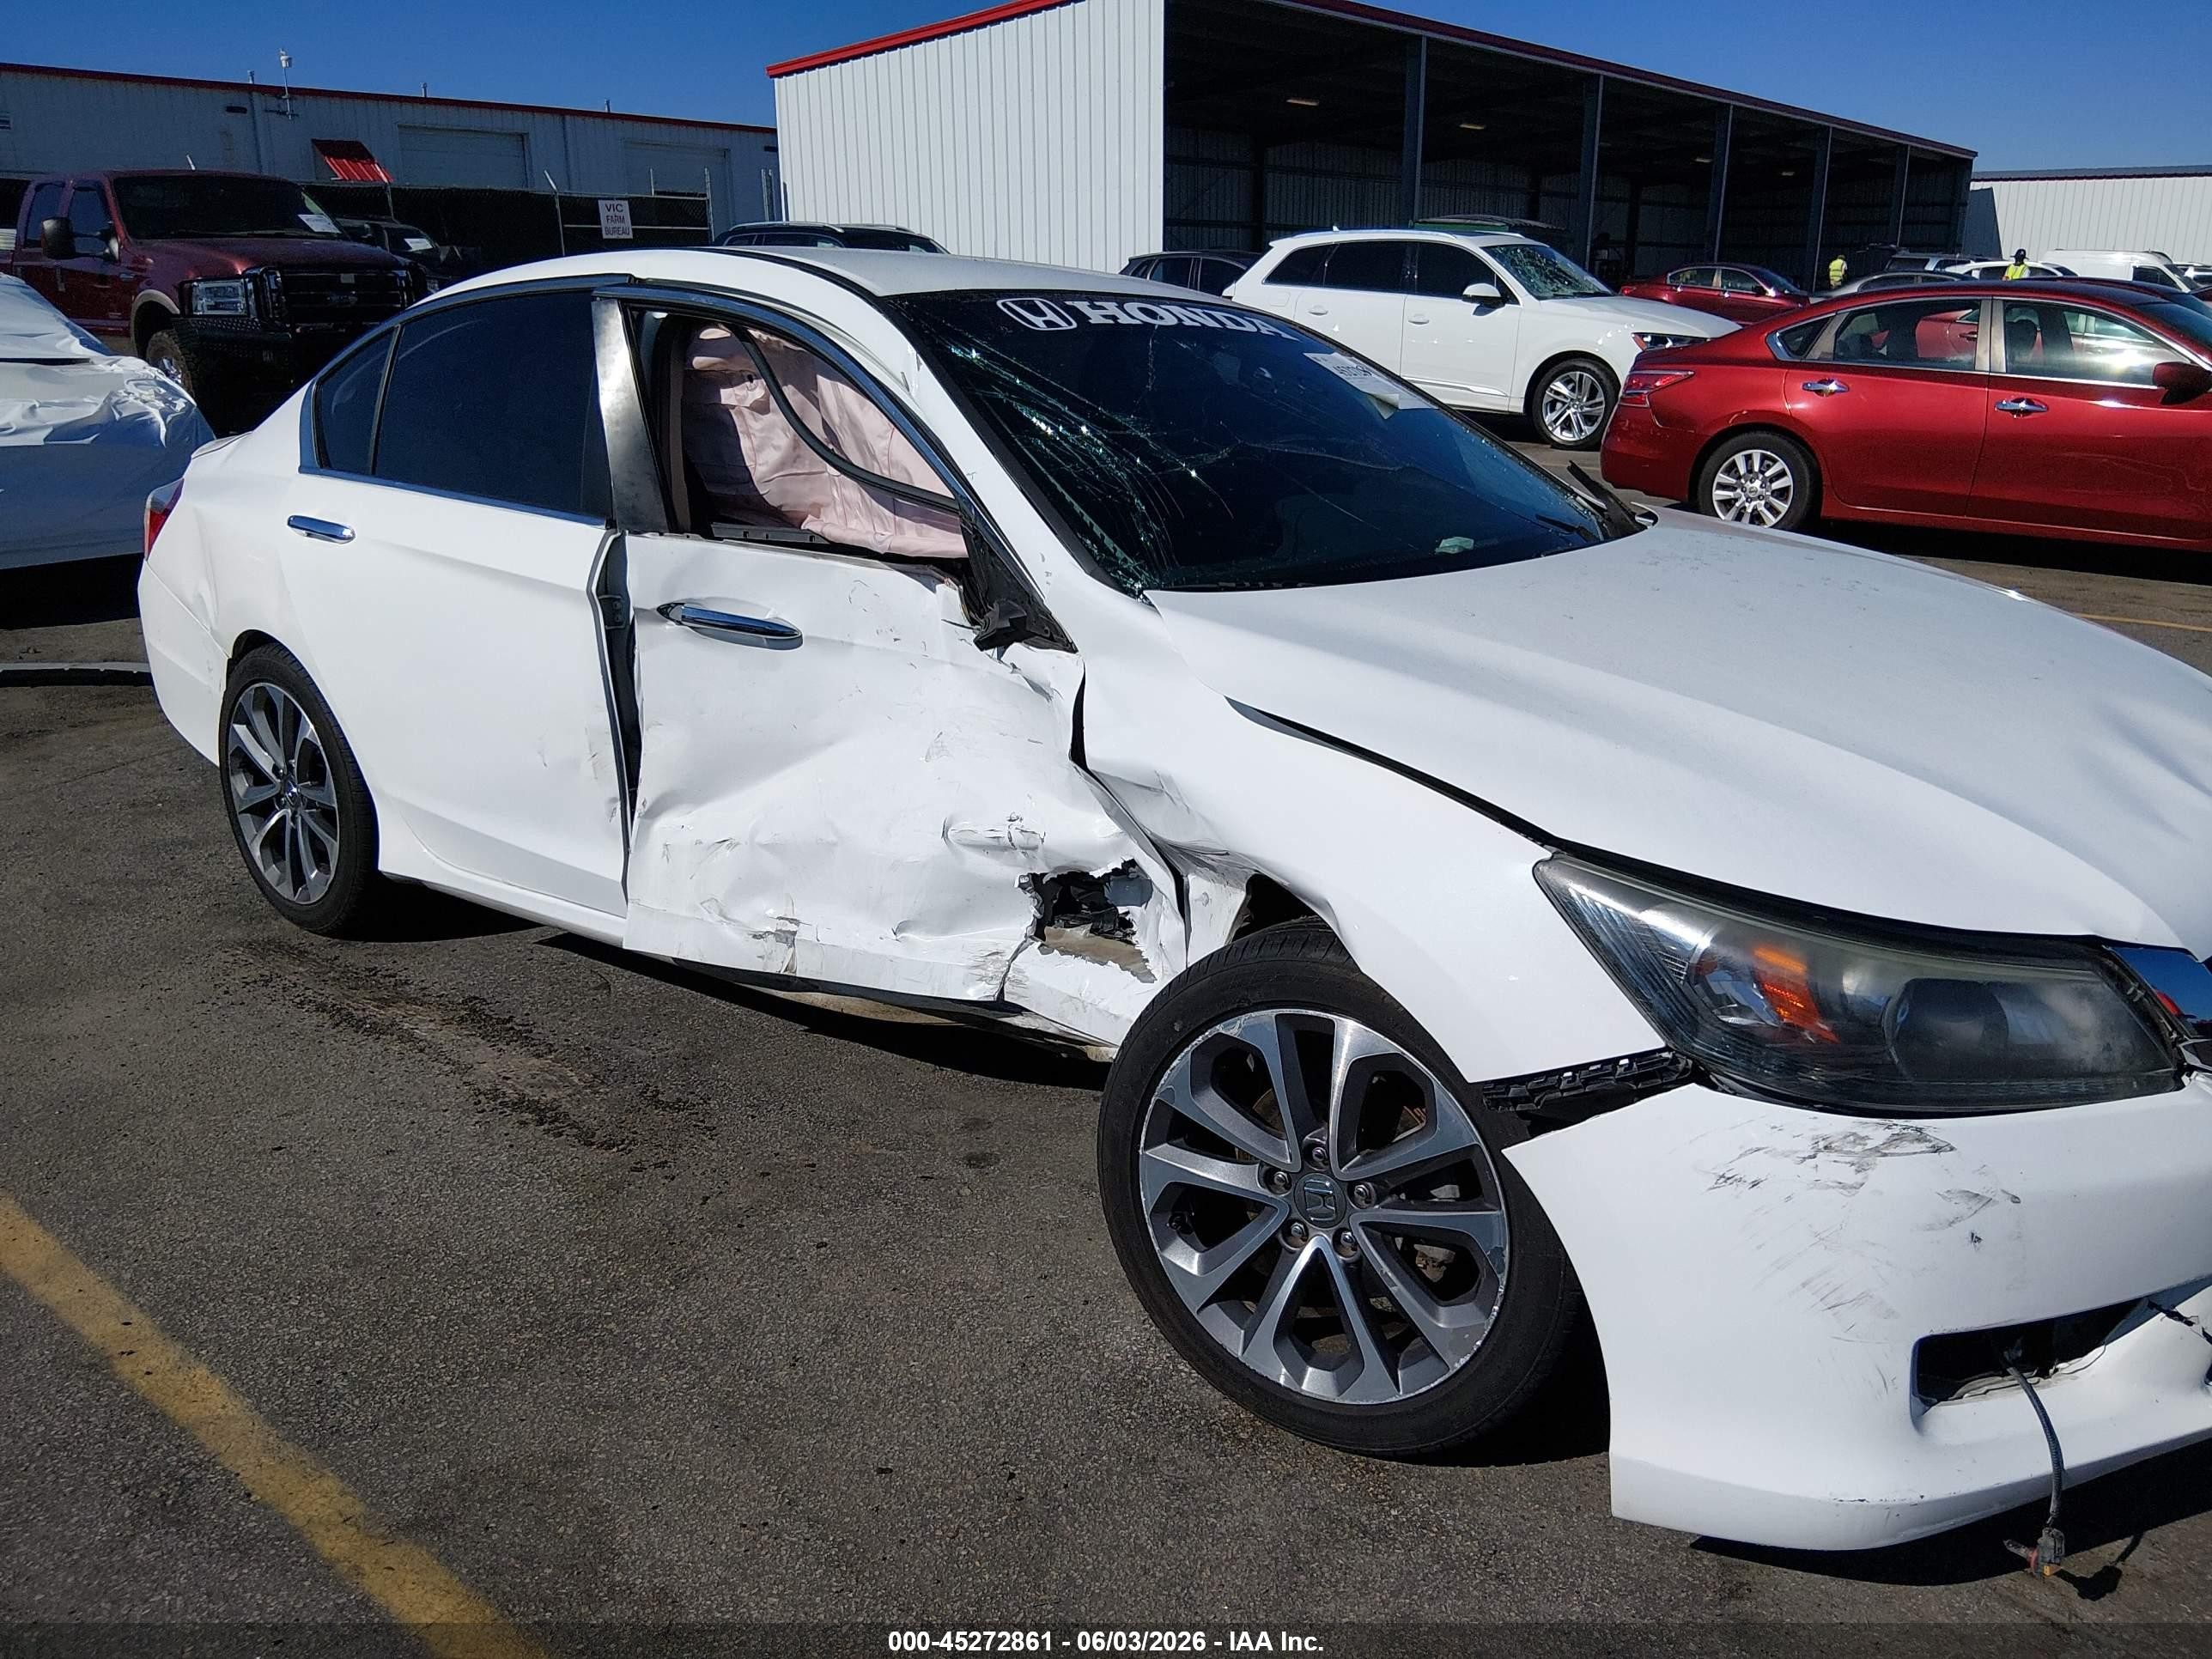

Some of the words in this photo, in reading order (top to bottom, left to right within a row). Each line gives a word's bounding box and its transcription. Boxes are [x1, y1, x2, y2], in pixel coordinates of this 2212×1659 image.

[605, 203, 624, 213] VIC
[605, 215, 626, 225] FARM
[605, 226, 630, 236] BUREAU
[1064, 301, 1299, 341] HONDA
